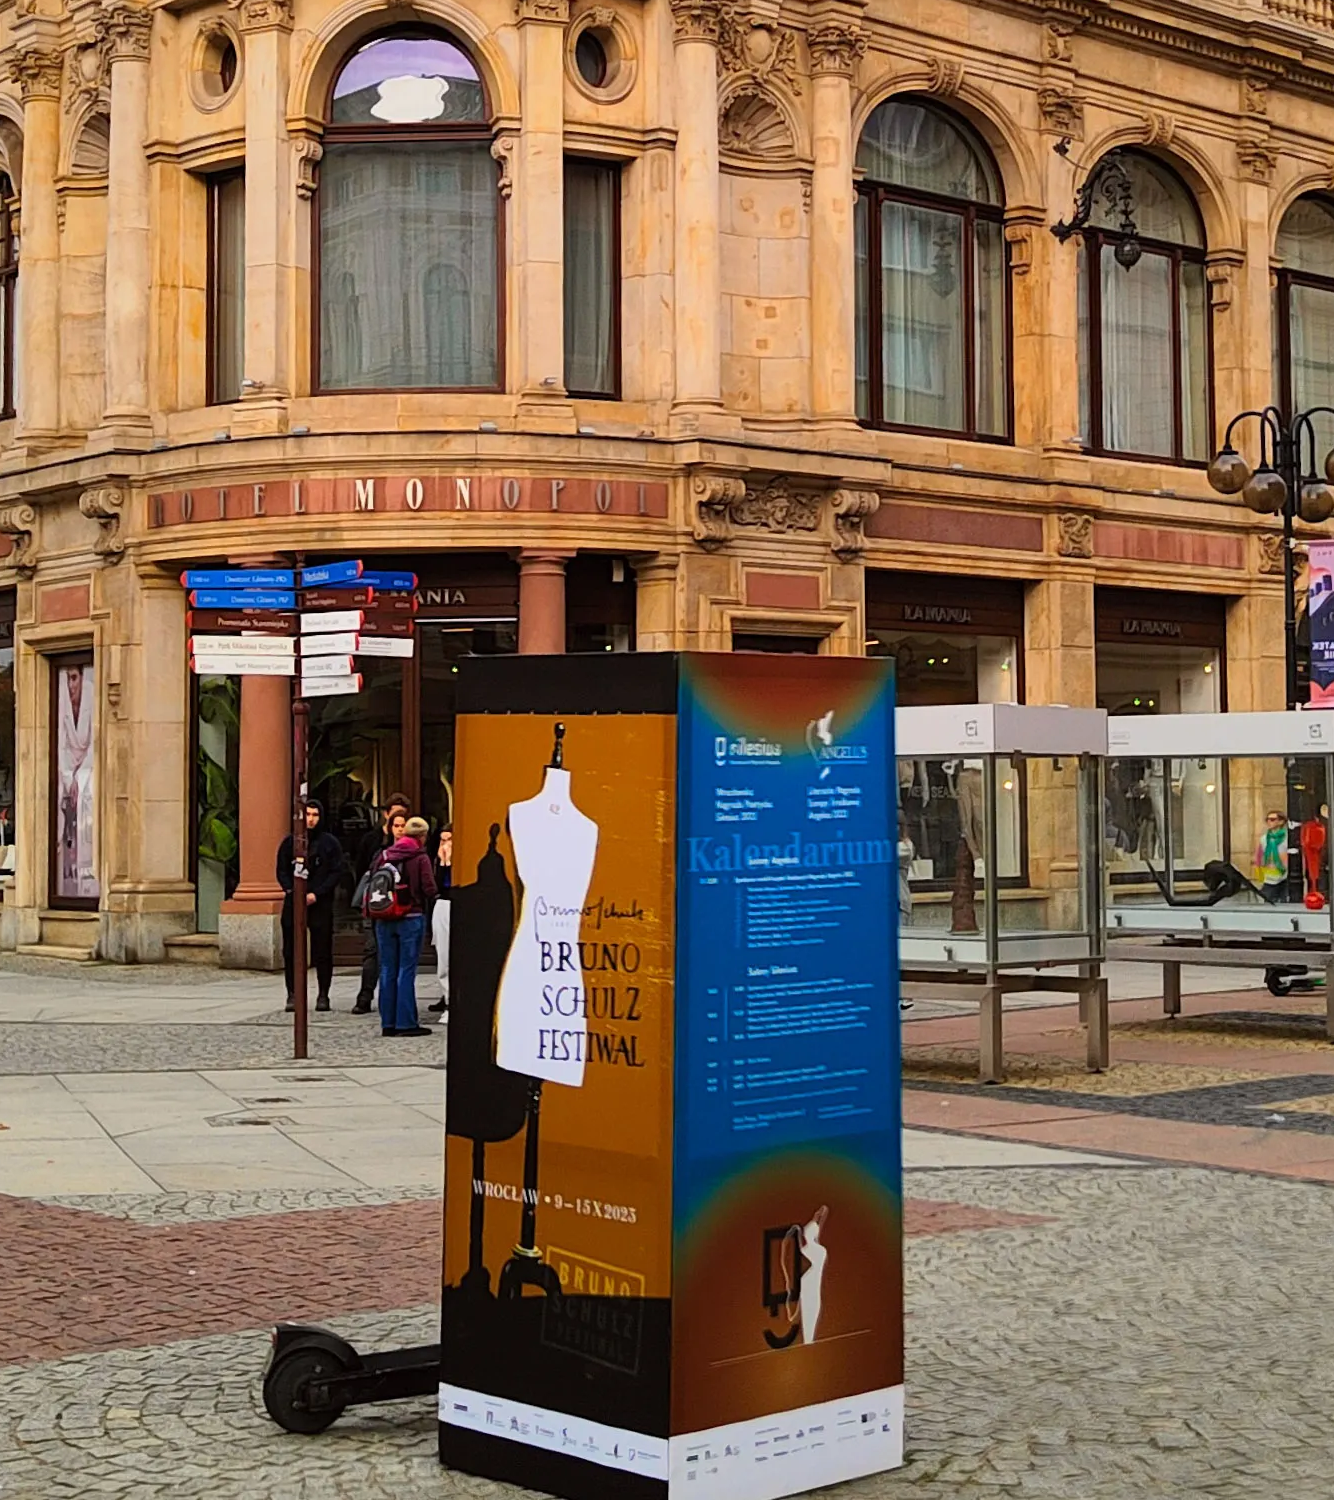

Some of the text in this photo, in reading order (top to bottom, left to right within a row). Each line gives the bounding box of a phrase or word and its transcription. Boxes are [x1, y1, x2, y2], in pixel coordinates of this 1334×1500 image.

[153, 478, 648, 527] HOTEL MONOPOL
[687, 831, 893, 873] Kalendarium
[540, 941, 641, 973] BRUNO
[540, 985, 642, 1021] SCHULZ
[536, 1029, 646, 1067] FESTIWAL
[473, 1179, 540, 1205] WROCŁAW
